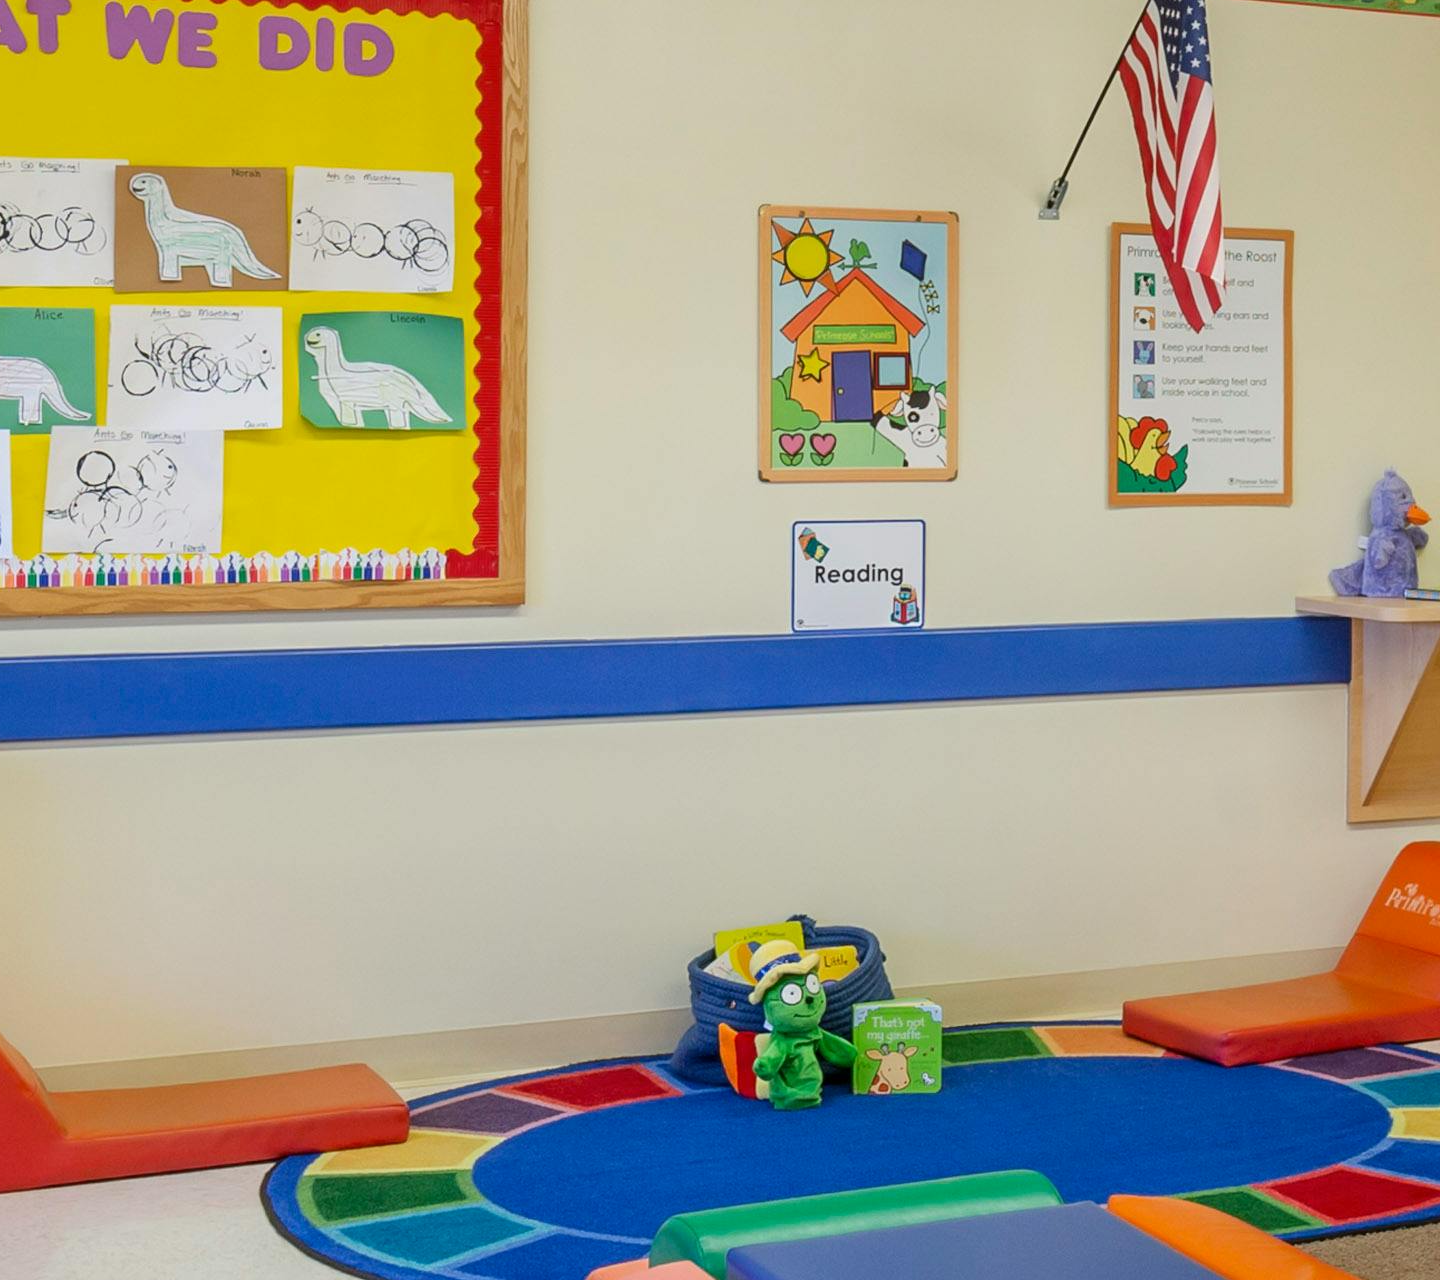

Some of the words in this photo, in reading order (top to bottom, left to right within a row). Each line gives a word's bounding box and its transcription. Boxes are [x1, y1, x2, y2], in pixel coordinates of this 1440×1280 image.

[106, 1, 219, 70] WE
[259, 15, 396, 78] DID
[1246, 251, 1277, 264] Roost
[34, 309, 64, 320] Alice
[1162, 344, 1184, 353] Keep
[1205, 344, 1231, 353] hands
[1232, 344, 1250, 353] and
[1162, 377, 1176, 386] Use
[1179, 378, 1197, 387] your
[1197, 377, 1230, 387] walking
[1250, 378, 1267, 386] and
[1187, 389, 1209, 397] voice
[1211, 389, 1220, 397] in
[815, 563, 904, 586] Reading
[823, 953, 849, 968] Little
[871, 1016, 903, 1029] That's
[907, 1017, 925, 1029] not
